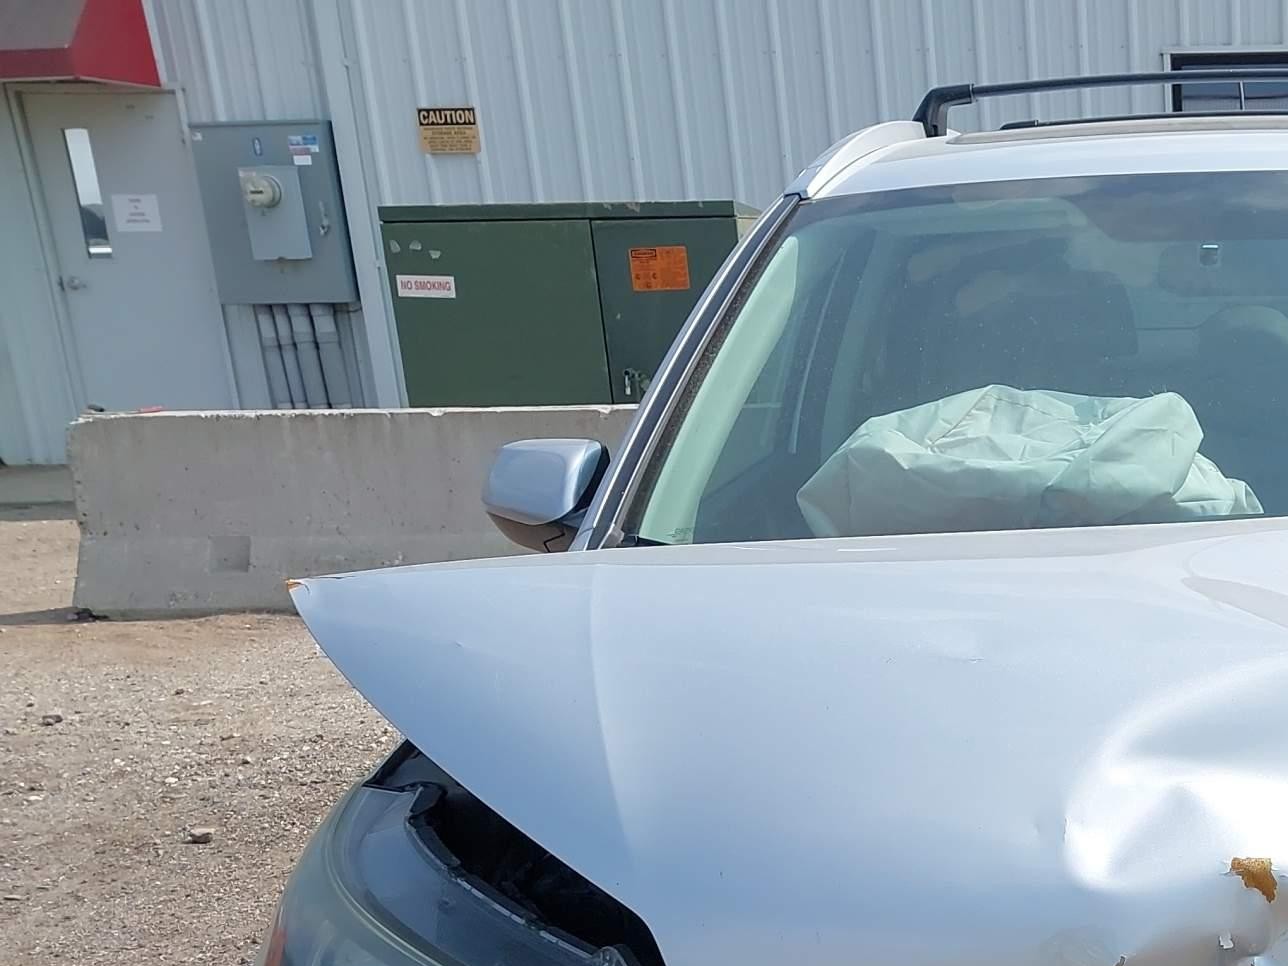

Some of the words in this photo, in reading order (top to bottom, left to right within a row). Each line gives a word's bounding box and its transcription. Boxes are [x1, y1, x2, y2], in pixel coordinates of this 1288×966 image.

[420, 109, 474, 125] CAUTION
[400, 280, 412, 290] NO
[415, 280, 451, 291] SMOKING
